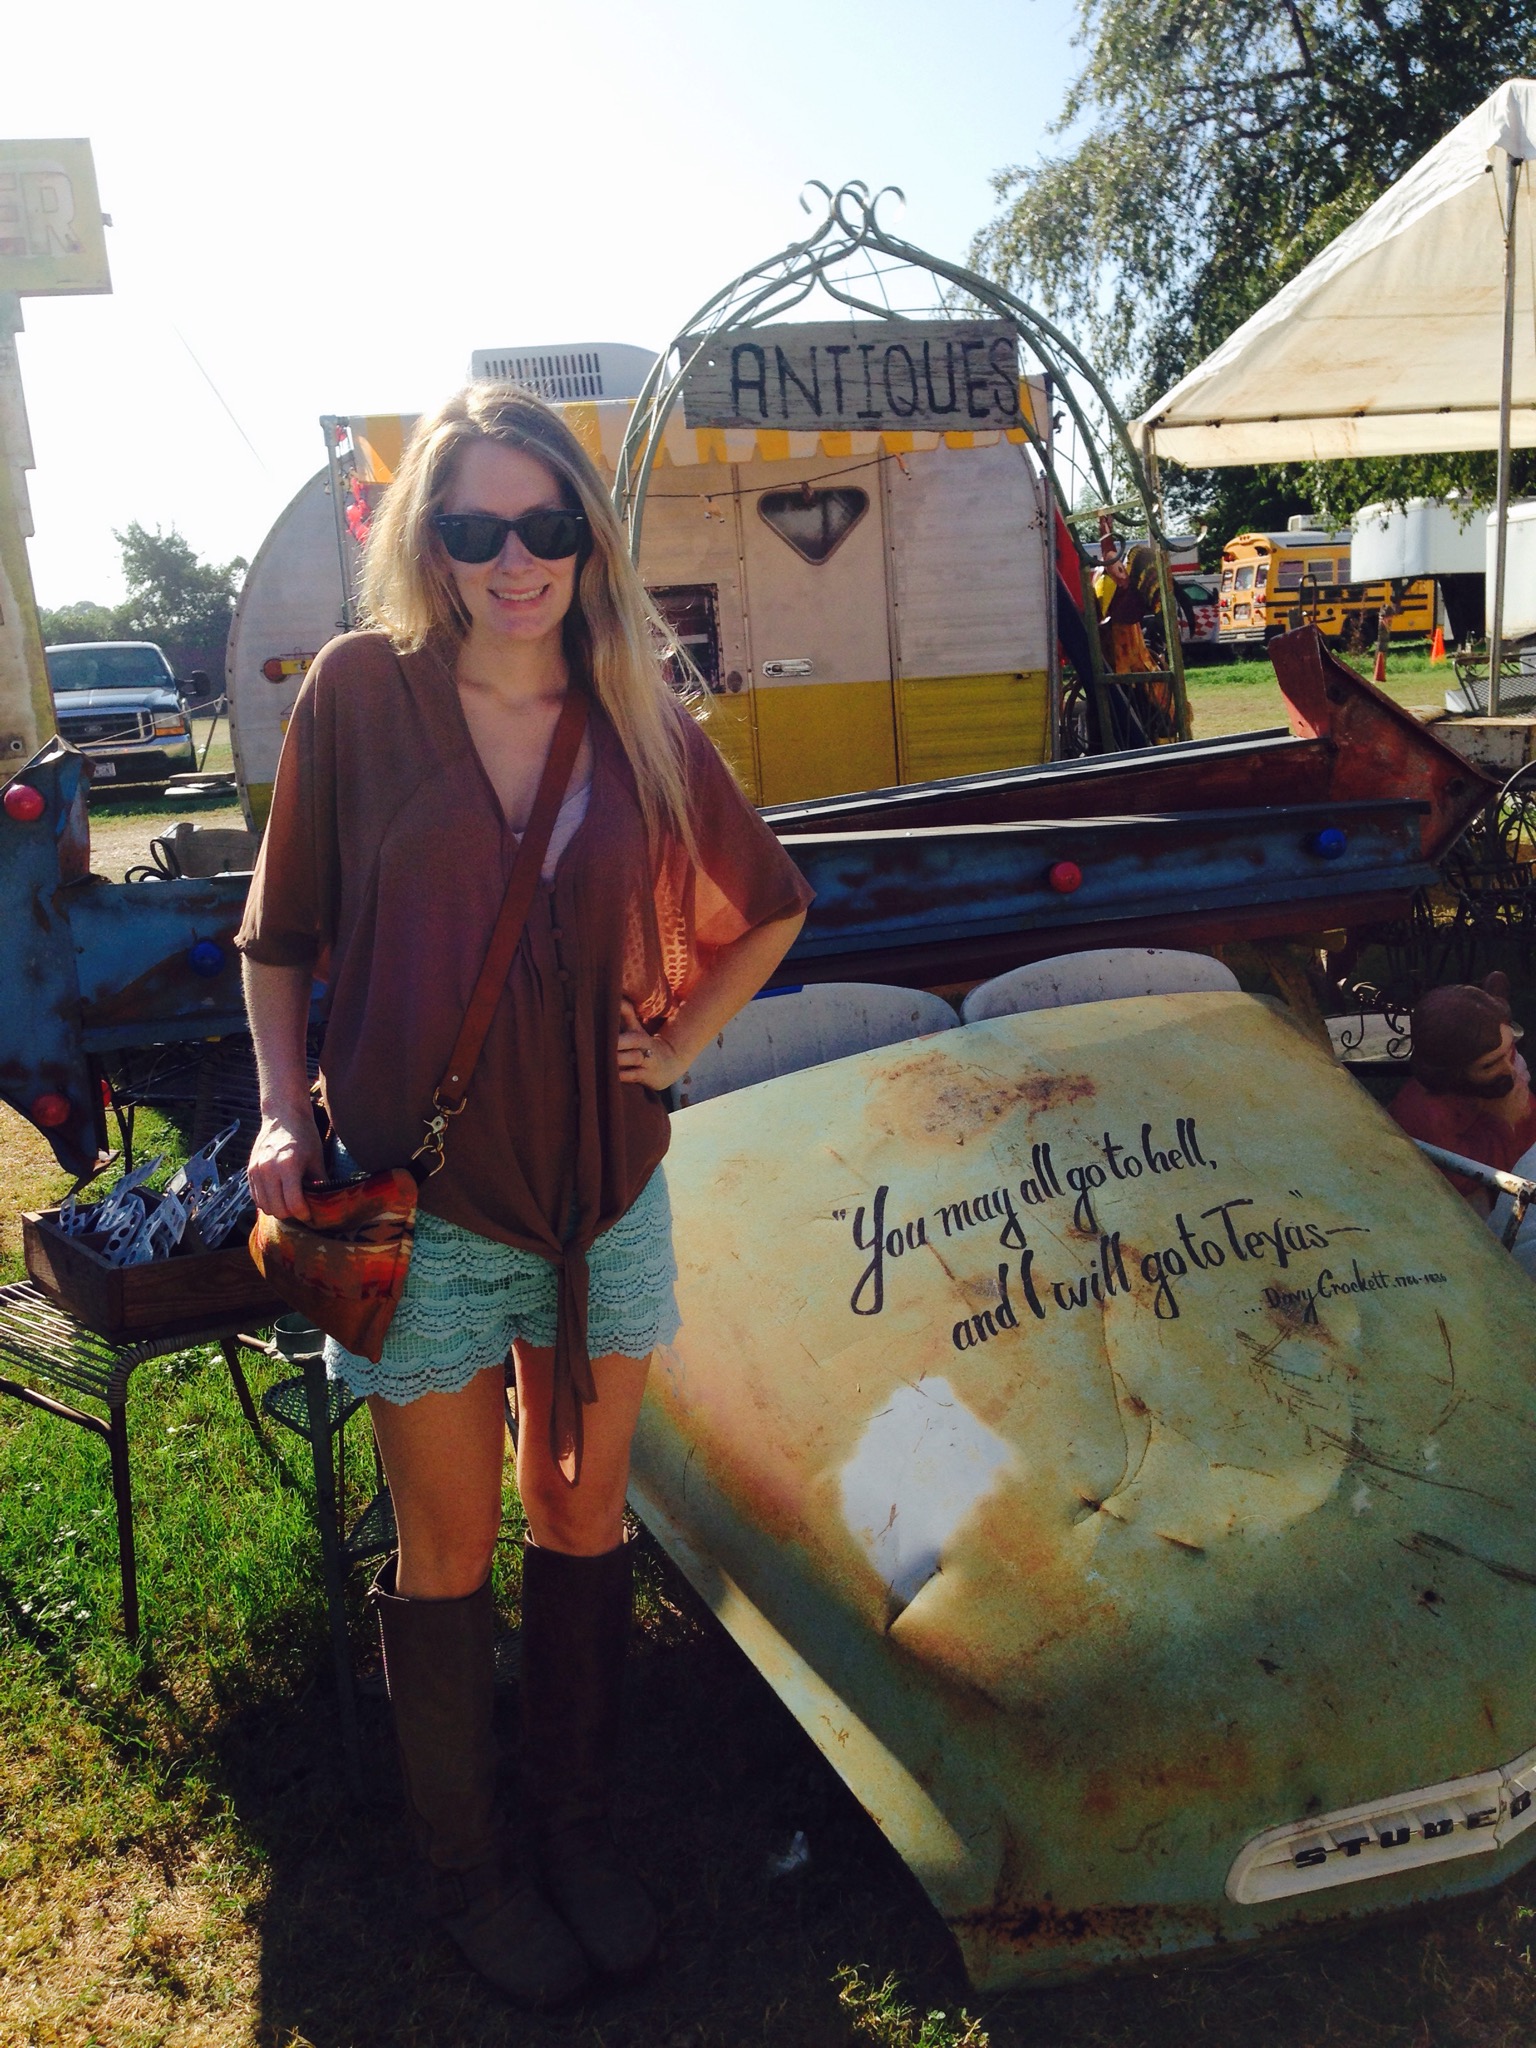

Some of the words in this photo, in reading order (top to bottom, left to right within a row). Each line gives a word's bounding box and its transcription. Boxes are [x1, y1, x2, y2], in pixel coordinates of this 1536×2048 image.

[731, 338, 1018, 419] ANTIQUES
[934, 1187, 1028, 1249] may
[1021, 1142, 1065, 1205] all
[952, 1263, 1020, 1351] and
[1051, 1231, 1132, 1311] will
